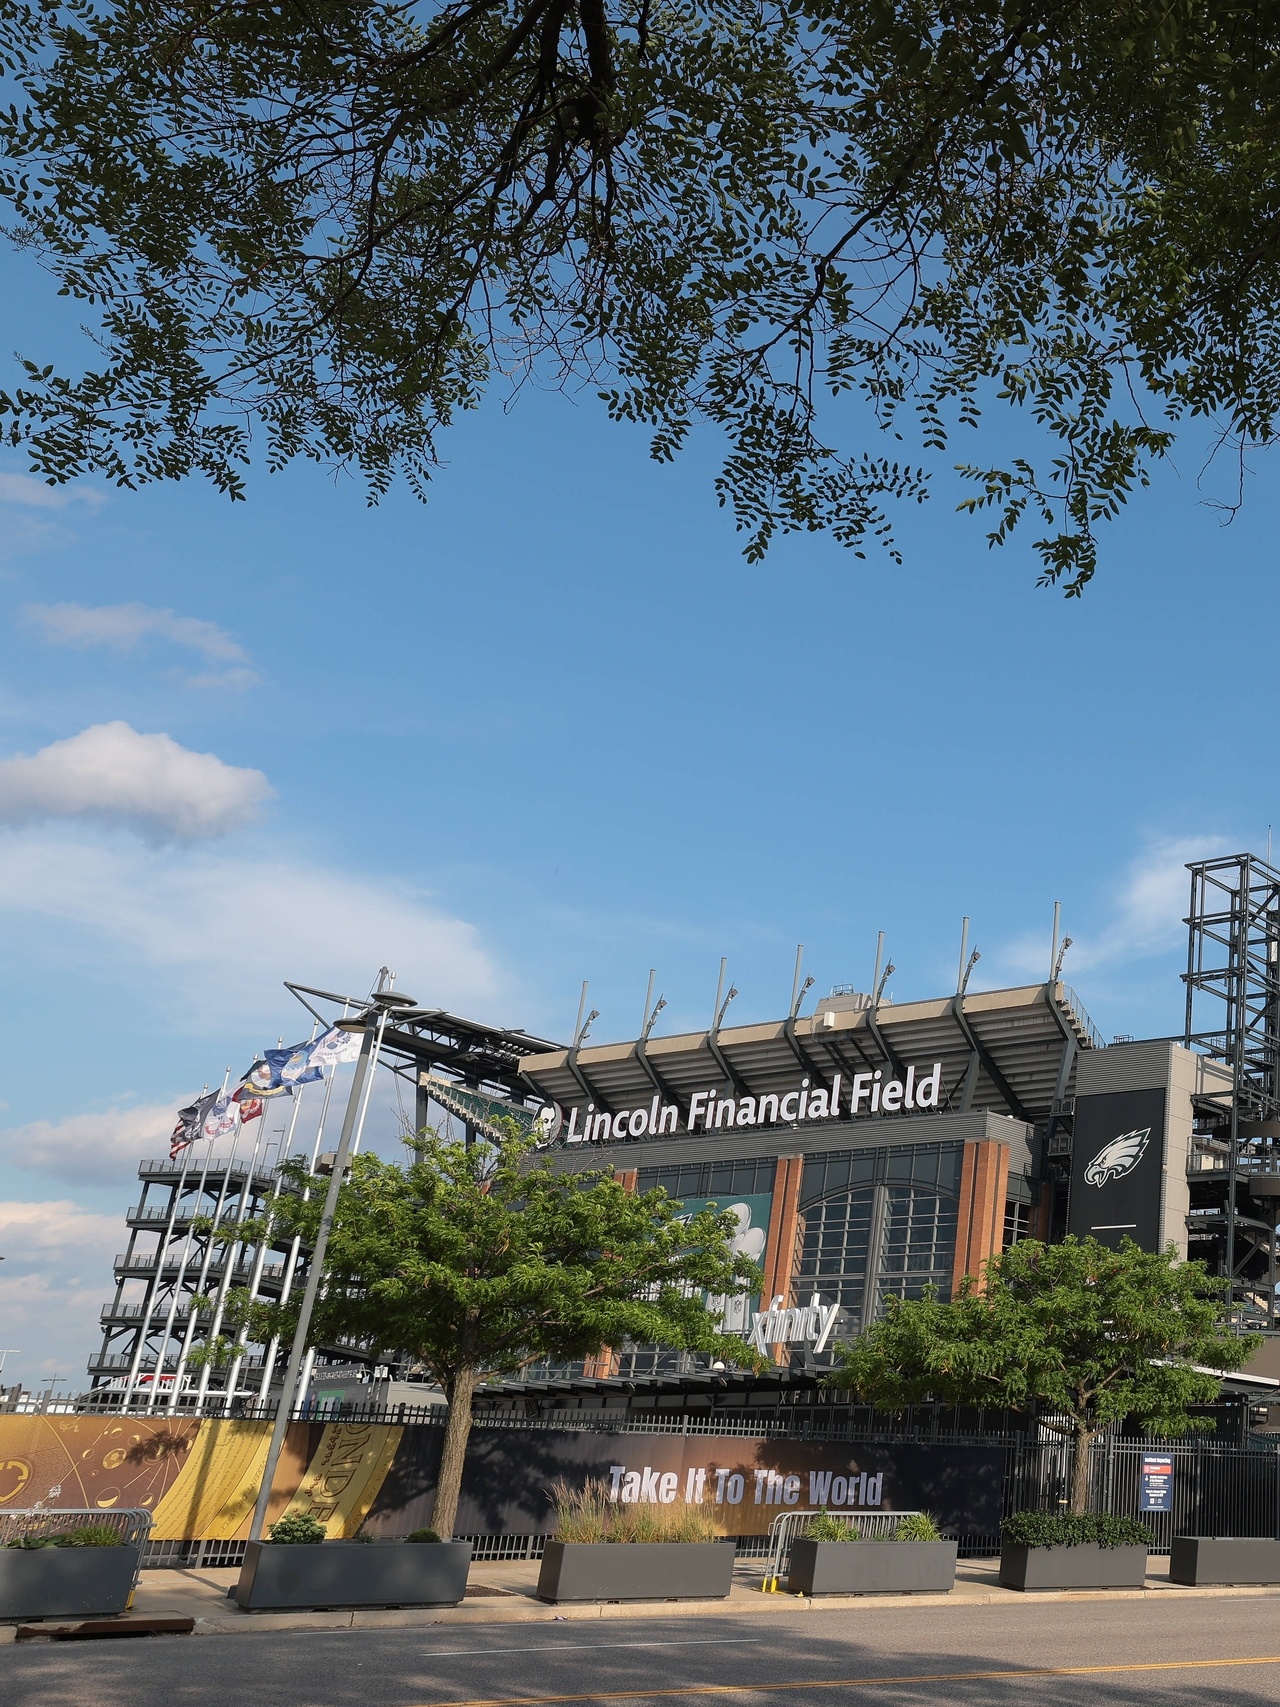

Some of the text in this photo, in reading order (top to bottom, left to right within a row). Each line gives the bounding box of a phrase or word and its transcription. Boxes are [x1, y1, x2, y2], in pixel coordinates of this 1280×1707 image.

[567, 1062, 942, 1143] Lincoln Financial Field
[747, 1292, 840, 1356] xfinity
[779, 1388, 851, 1404] XFINI
[608, 1465, 884, 1506] Take It To The World
